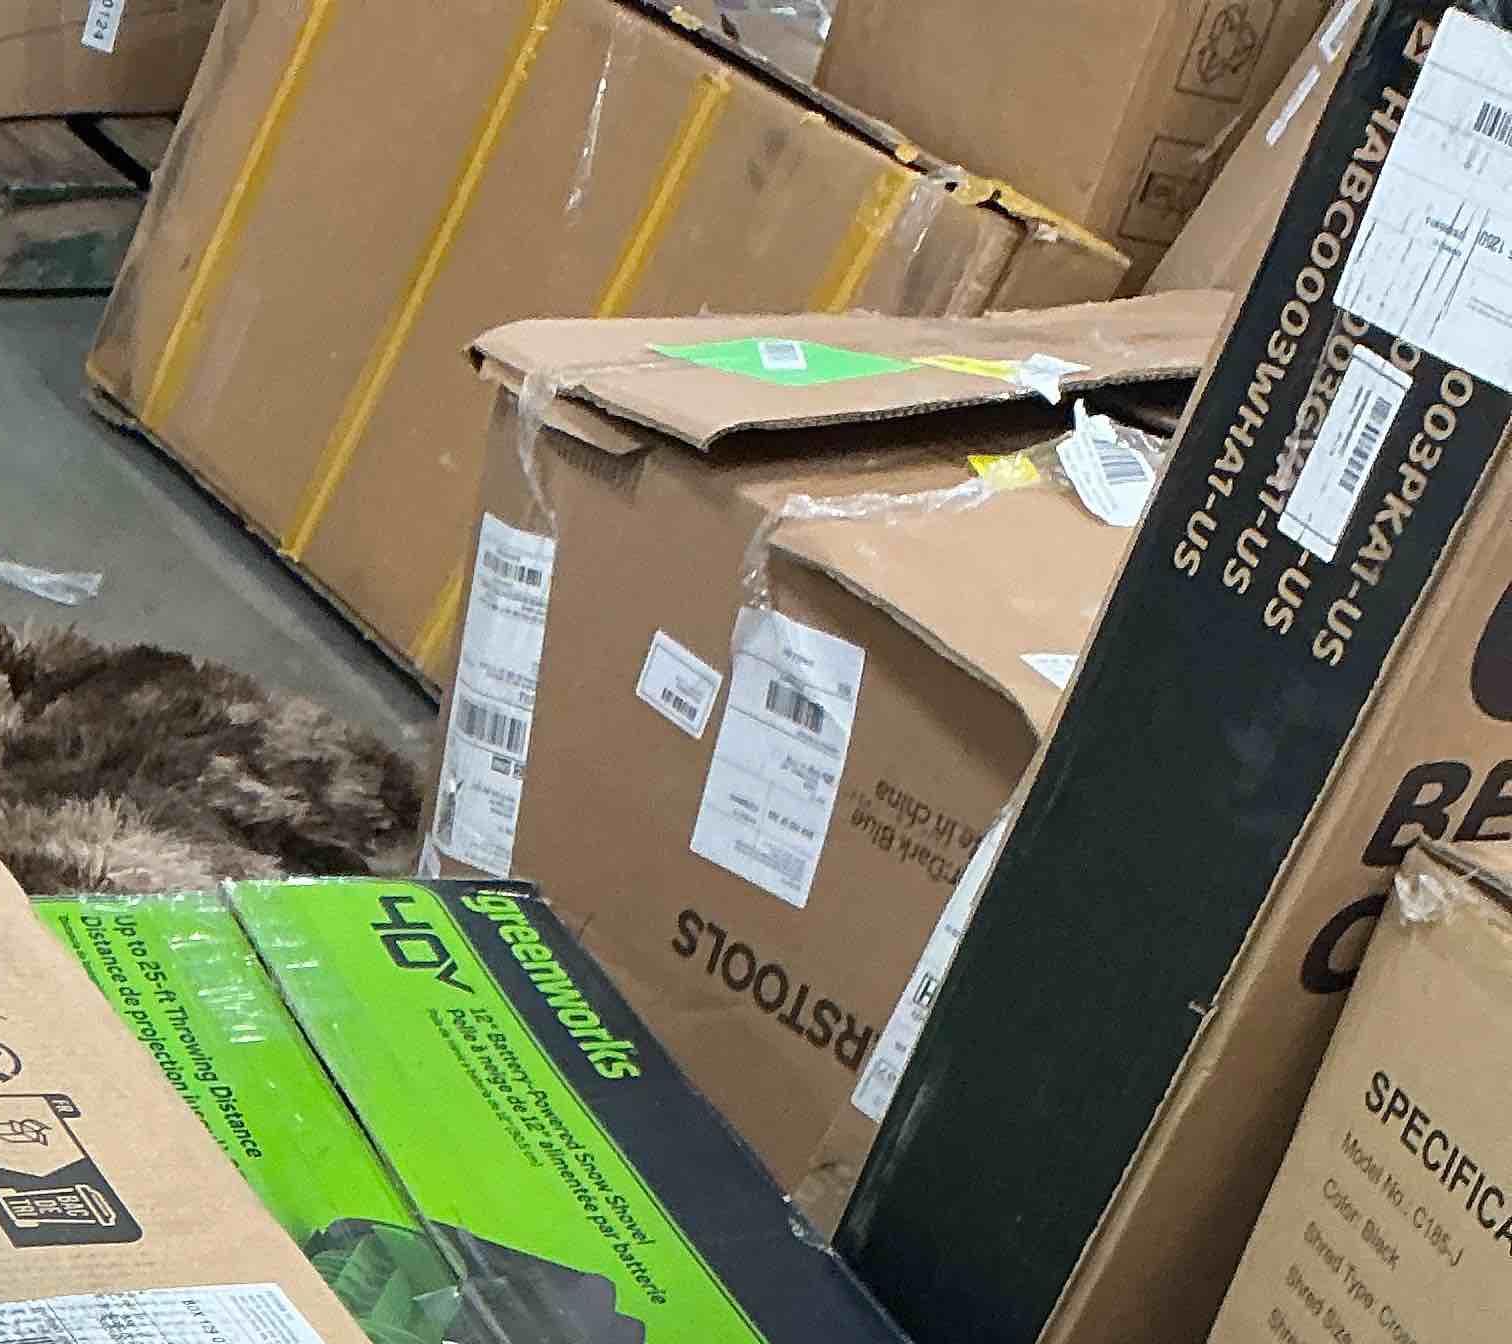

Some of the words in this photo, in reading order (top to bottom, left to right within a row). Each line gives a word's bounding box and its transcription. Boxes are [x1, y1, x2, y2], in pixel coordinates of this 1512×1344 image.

[78, 915, 132, 982] Distance
[107, 915, 144, 936] Up
[127, 940, 151, 956] to
[117, 986, 143, 1005] de
[137, 961, 178, 1002] 25-ft
[459, 891, 651, 1079] greenworks
[125, 1010, 191, 1090] projection
[161, 1006, 222, 1081] Throwing
[210, 1086, 266, 1157] Distance
[471, 1056, 521, 1092] neige
[505, 1095, 535, 1112] de
[537, 1142, 604, 1212] alimentée
[583, 1215, 621, 1239] par
[612, 1243, 673, 1305] batterie
[1365, 1070, 1512, 1258] SPECIFICA
[7, 1199, 39, 1217] TRI
[32, 1199, 63, 1214] DE
[55, 1195, 89, 1216] BAC
[570, 1152, 616, 1192] Snow
[601, 1195, 657, 1245] Shovel
